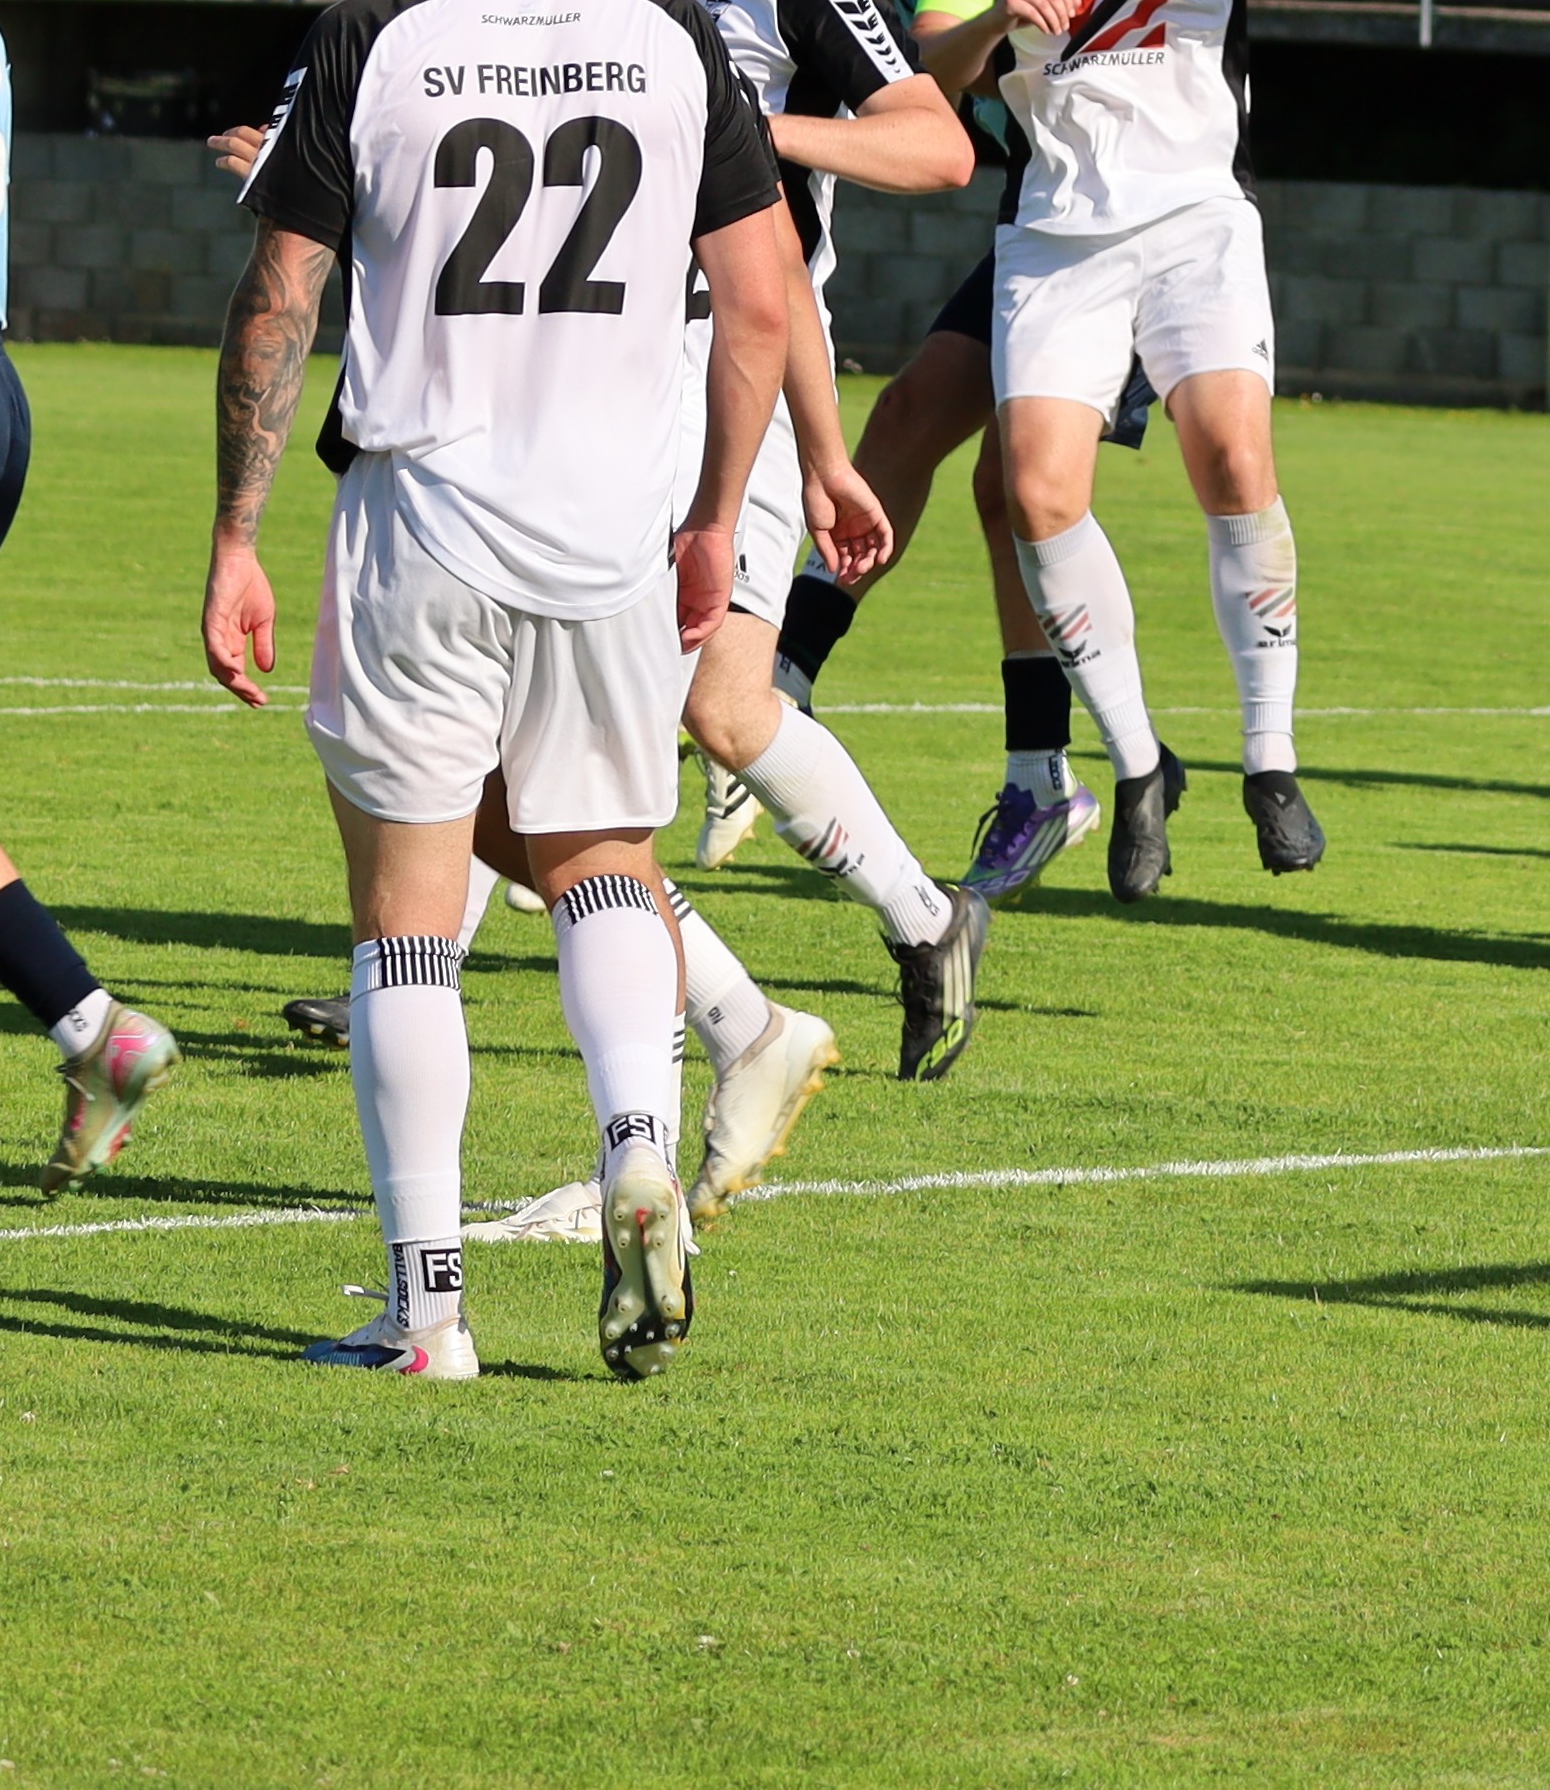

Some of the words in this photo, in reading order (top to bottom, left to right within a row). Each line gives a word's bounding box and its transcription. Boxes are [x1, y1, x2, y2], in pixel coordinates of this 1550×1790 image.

[422, 66, 466, 98] SV
[477, 61, 647, 97] FREINBERG
[433, 115, 643, 316] 22
[610, 1114, 653, 1146] FS
[424, 1252, 463, 1289] FS
